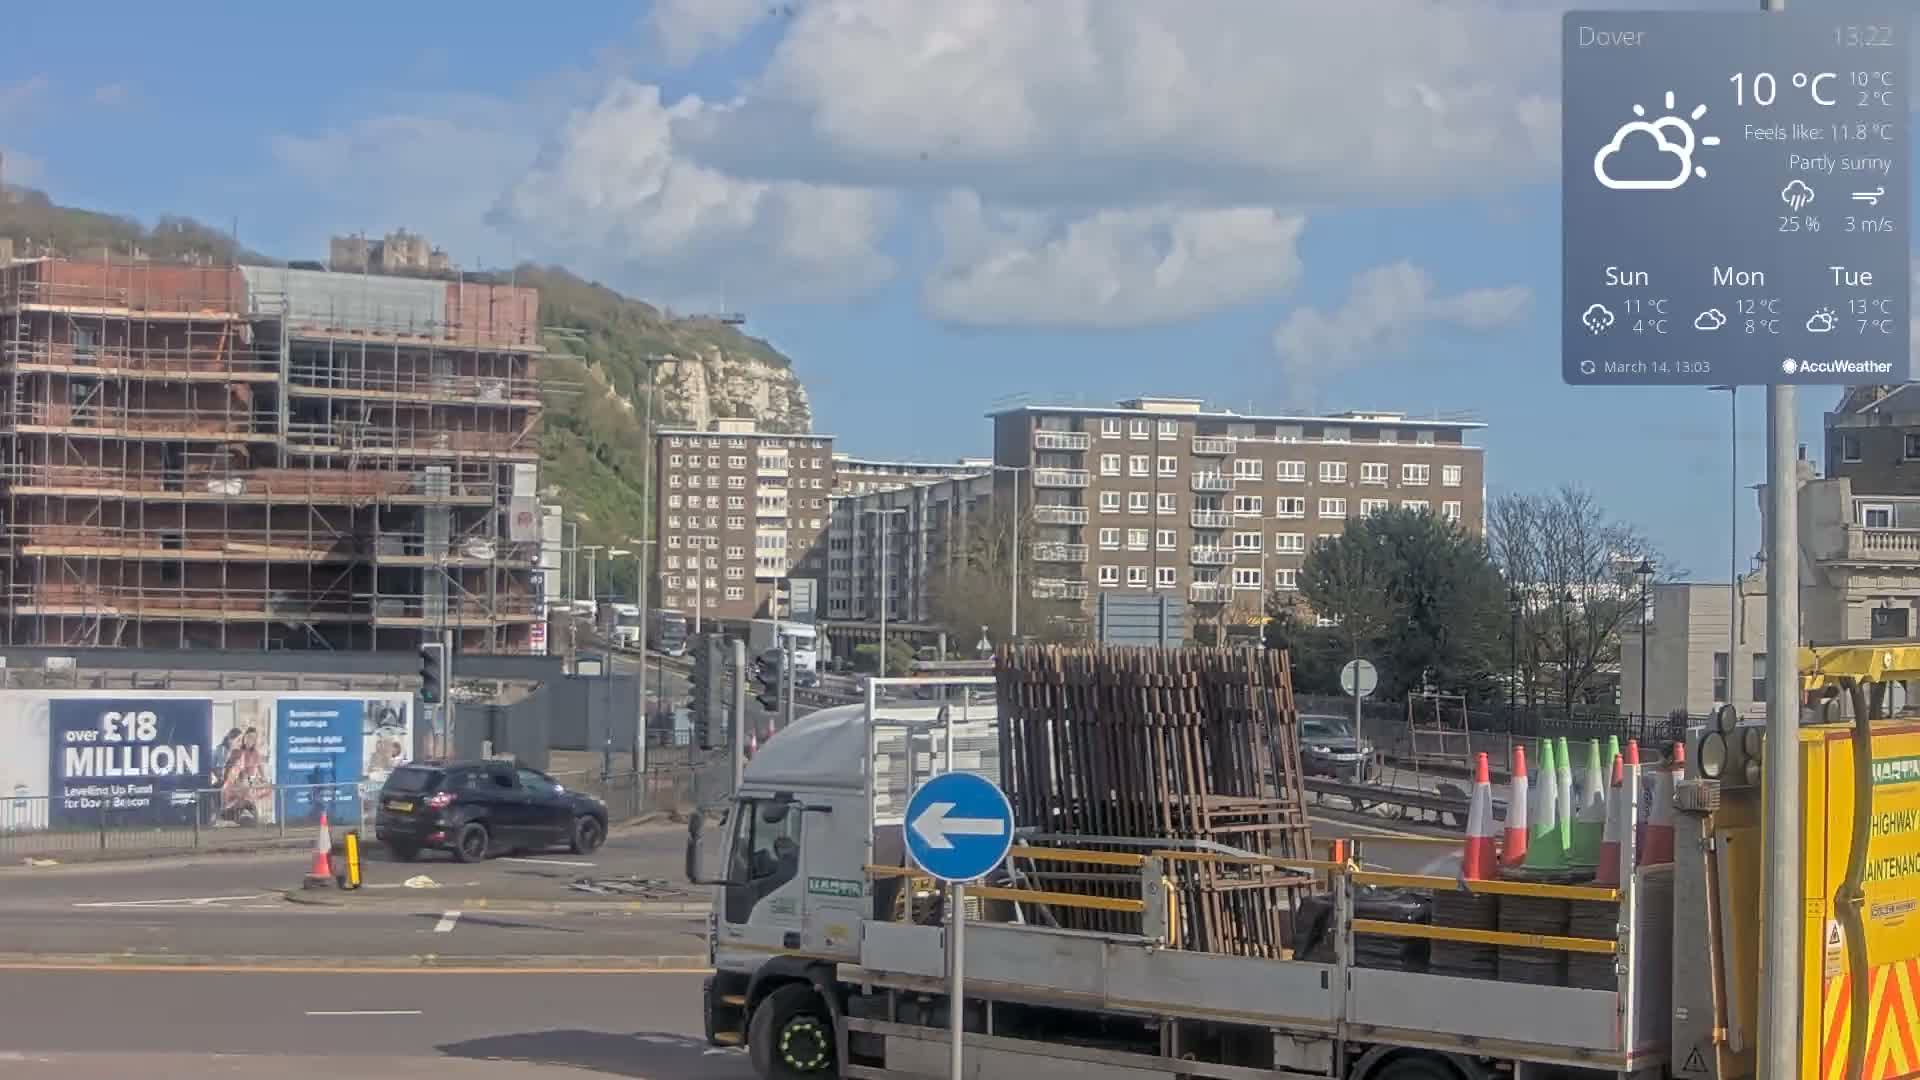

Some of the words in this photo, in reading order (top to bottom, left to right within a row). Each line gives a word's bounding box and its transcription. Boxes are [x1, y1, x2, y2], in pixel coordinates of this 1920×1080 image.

[65, 730, 99, 742] over
[103, 711, 158, 742] £18
[65, 745, 200, 777] MILLION
[1872, 810, 1917, 837] HIGHWAY
